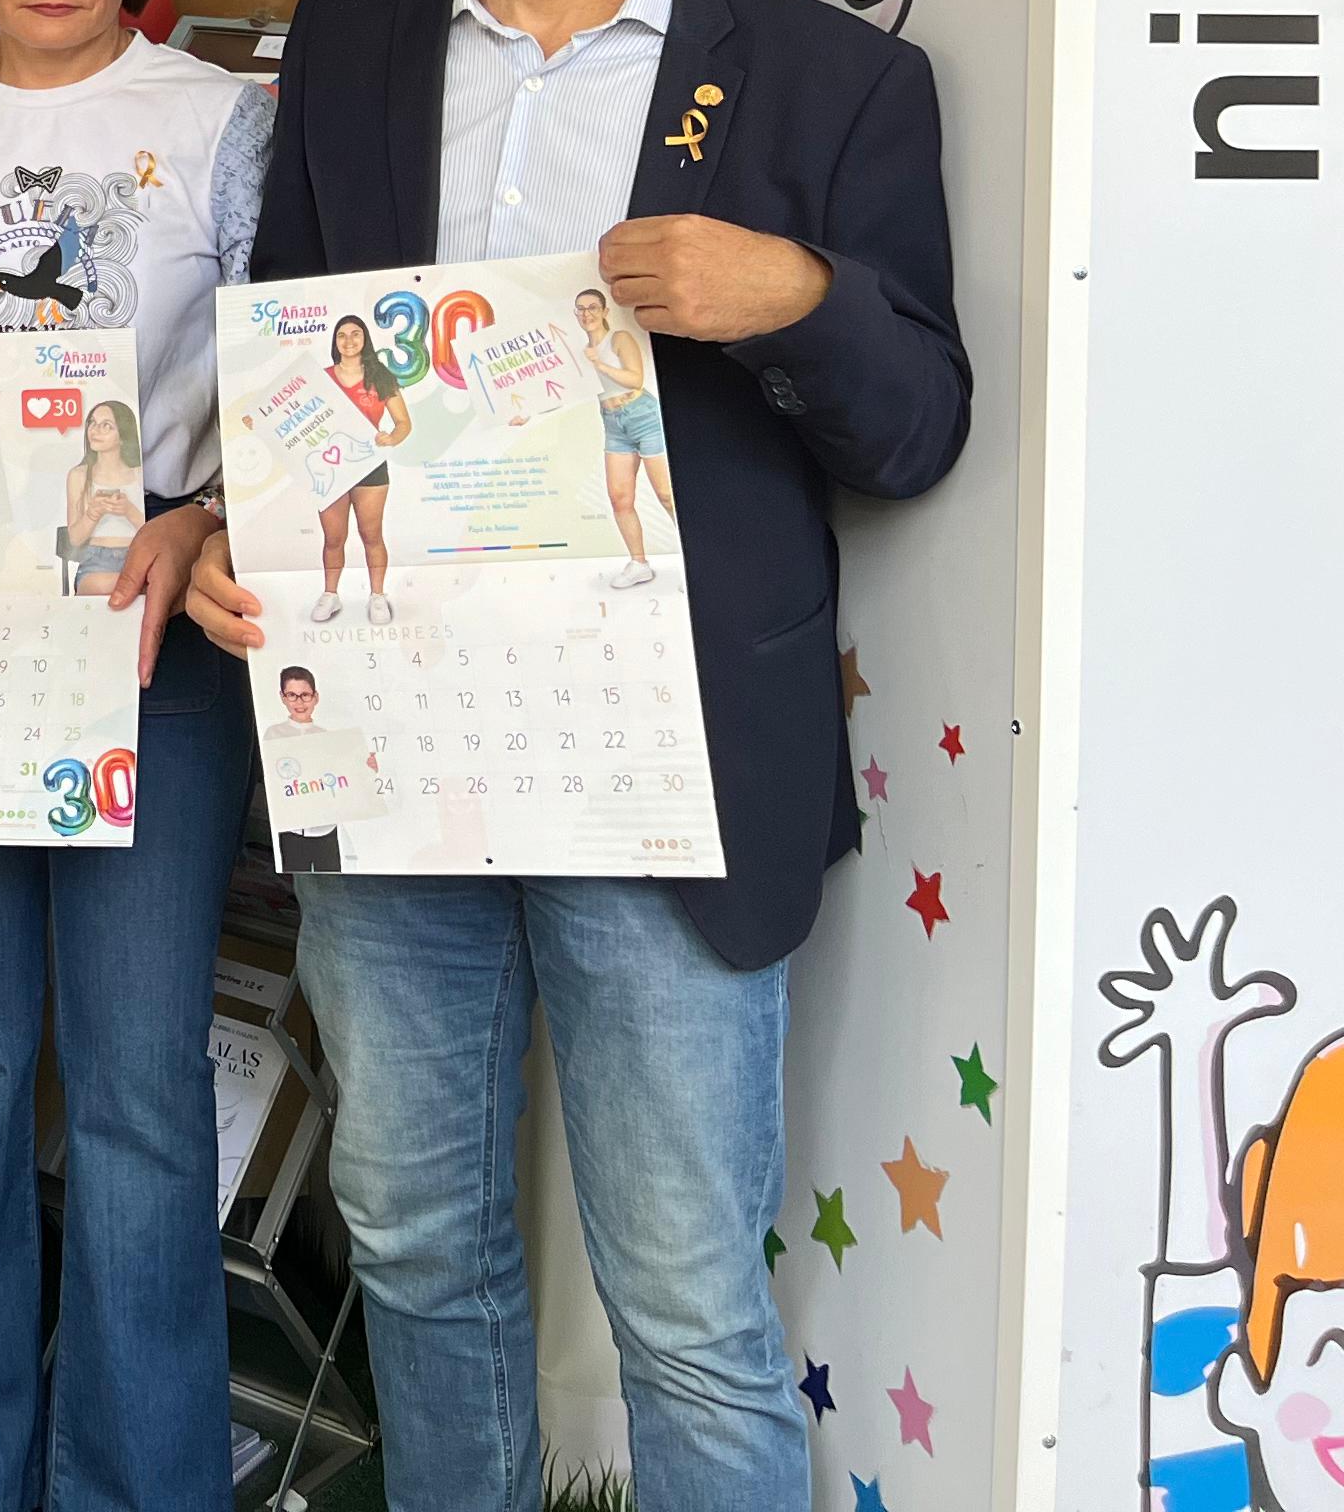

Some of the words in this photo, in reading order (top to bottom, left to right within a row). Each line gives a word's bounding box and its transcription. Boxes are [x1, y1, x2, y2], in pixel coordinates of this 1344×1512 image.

[281, 304, 328, 320] Añazos
[277, 319, 328, 336] Ilusión
[485, 345, 500, 361] TU
[502, 335, 528, 356] ERES
[530, 329, 546, 344] LA
[534, 341, 555, 358] QUE
[63, 349, 107, 365] Añazos
[59, 363, 106, 378] Ilusión
[492, 373, 515, 390] NOS
[516, 355, 563, 384] IMPULSA
[258, 405, 272, 418] La
[271, 375, 307, 407] ILUSIÓN
[53, 399, 77, 417] 30
[274, 395, 326, 439] ESPERANZA
[284, 408, 292, 417] y
[289, 399, 301, 411] la
[285, 436, 301, 450] son
[300, 407, 335, 438] nuestras
[304, 428, 330, 448] ALAS
[2, 628, 10, 641] 2
[40, 627, 49, 640] 3
[80, 625, 88, 637] 4
[31, 693, 45, 706] 17
[71, 692, 85, 706] 18
[20, 762, 37, 776] 31
[43, 748, 135, 837] 30
[283, 771, 349, 800] afanion
[374, 779, 394, 794] 24
[420, 778, 439, 794] 25
[467, 778, 487, 794] 26
[514, 777, 534, 793] 27
[563, 776, 583, 792] 28
[612, 776, 633, 792] 29
[663, 775, 683, 791] 30
